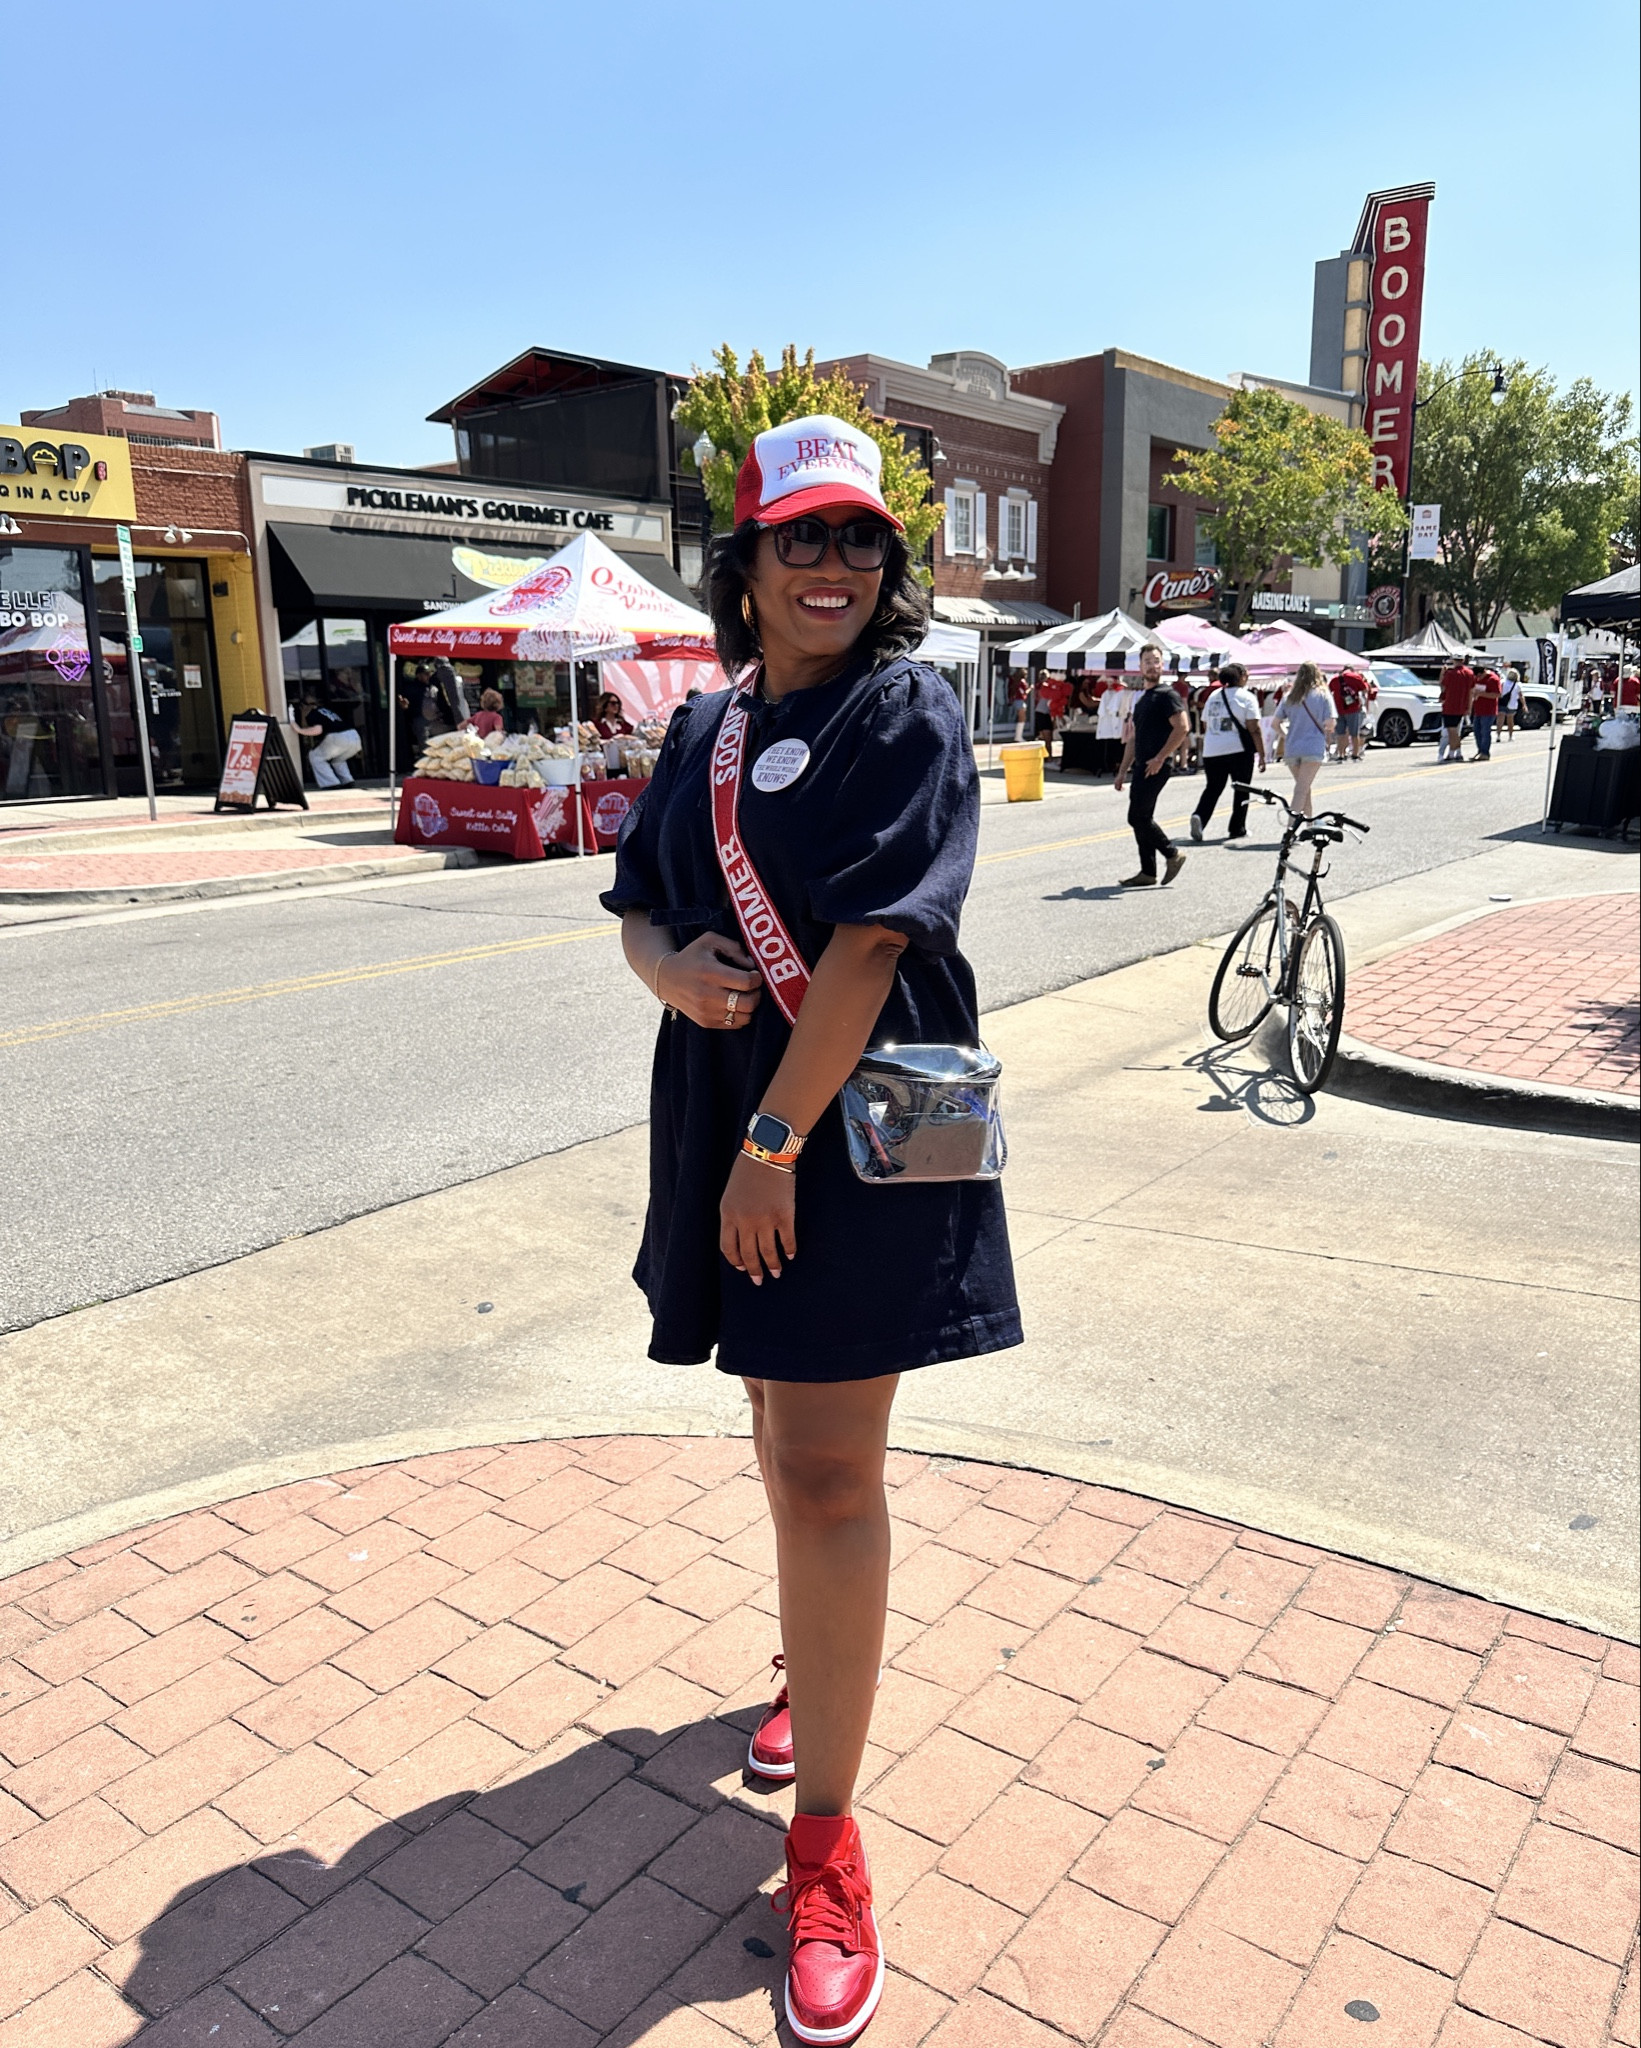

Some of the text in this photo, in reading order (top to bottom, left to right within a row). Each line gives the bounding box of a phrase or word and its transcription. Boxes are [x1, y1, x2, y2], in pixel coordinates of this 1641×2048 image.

[1372, 216, 1412, 489] BOOMER
[795, 438, 858, 461] BEAT
[777, 458, 875, 484] EVERYONE
[16, 486, 34, 499] IN
[41, 488, 52, 500] A
[58, 490, 91, 503] CUP
[347, 487, 614, 531] PICKLEMAN'S GOURMET CAFE
[1145, 570, 1214, 609] Cane's
[1285, 593, 1311, 612] CANE'S
[30, 612, 69, 627] BOP
[392, 629, 417, 643] Sweet
[416, 630, 433, 643] and
[433, 630, 457, 652] Salty
[458, 630, 482, 645] Kettle
[46, 648, 91, 665] OPEN
[228, 743, 253, 769] 7.95
[769, 747, 808, 756] THEY KNOW
[777, 757, 799, 765] KNOW
[757, 773, 787, 784] KNOWS
[450, 806, 475, 818] Sweet
[475, 808, 493, 819] and
[720, 834, 800, 985] BOOMER
